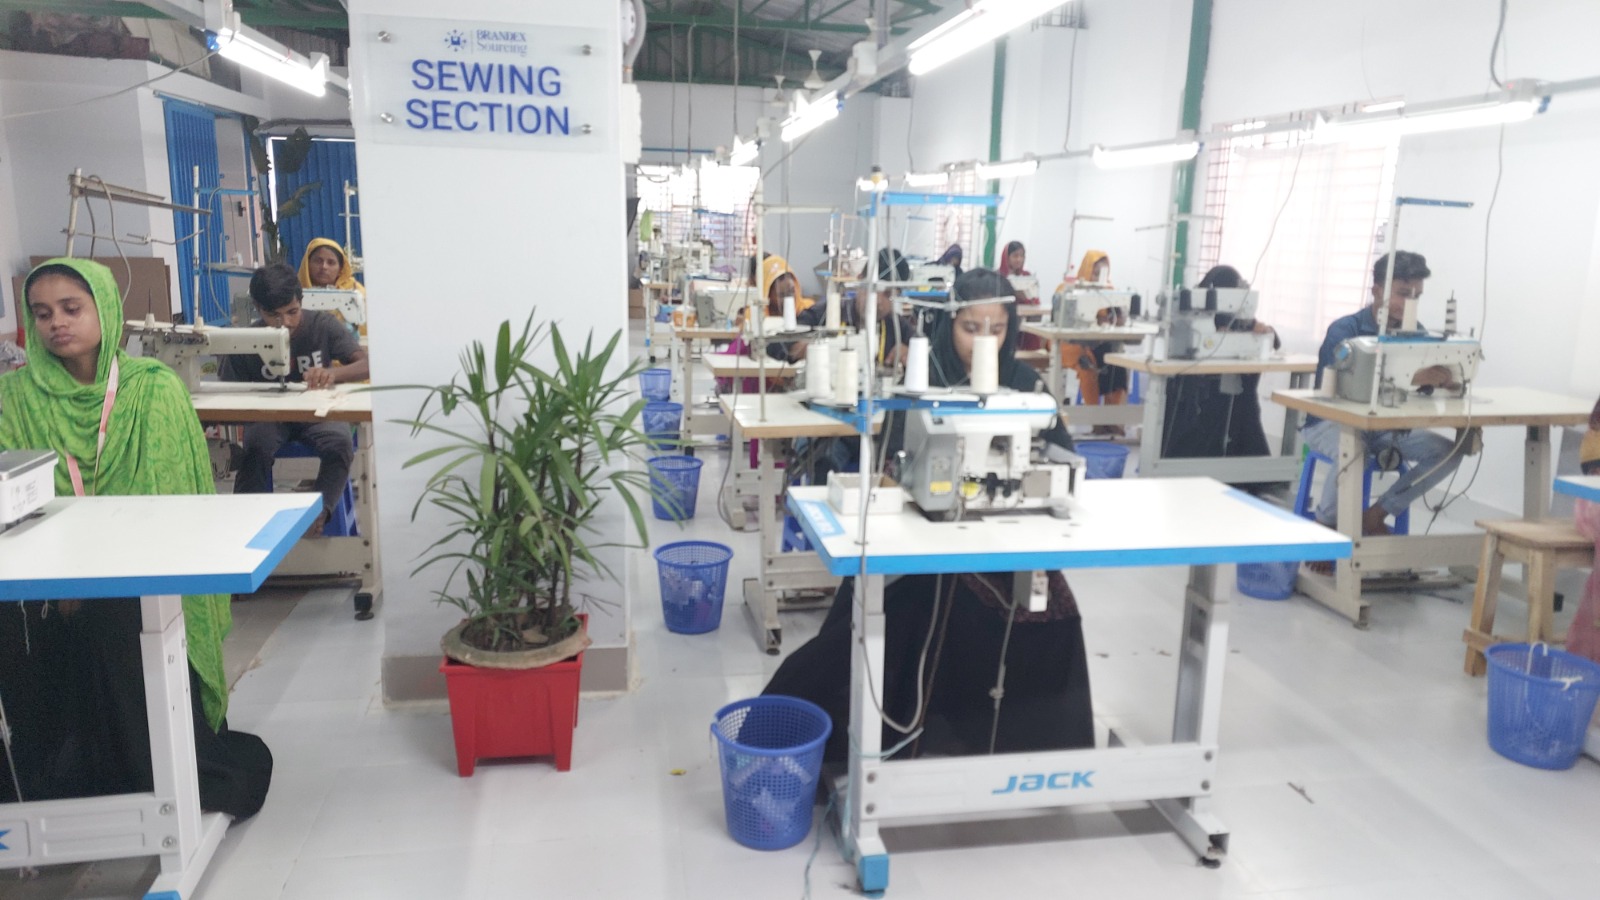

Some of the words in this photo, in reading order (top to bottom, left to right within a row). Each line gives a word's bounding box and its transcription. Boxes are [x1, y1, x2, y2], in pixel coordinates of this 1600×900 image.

[477, 29, 527, 42] BRANDEX
[477, 41, 528, 58] Sourcing
[411, 59, 561, 96] SEWING
[405, 98, 570, 135] SECTION
